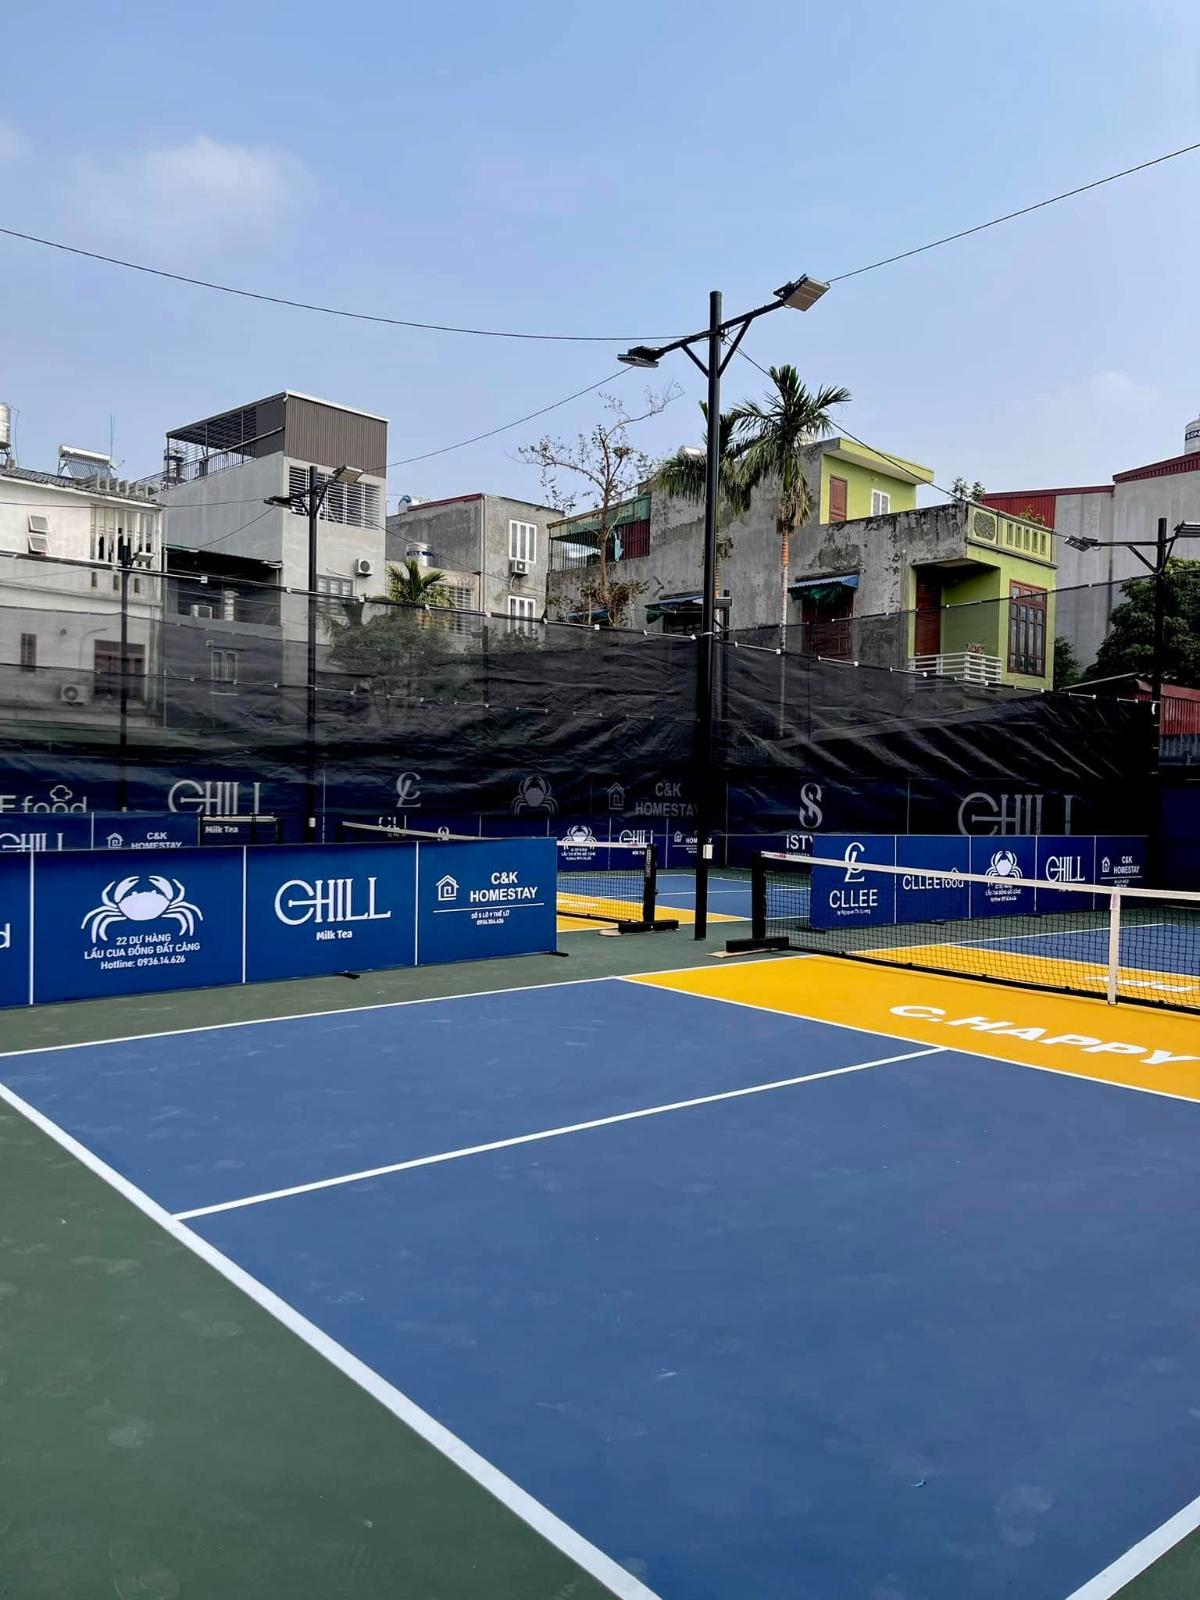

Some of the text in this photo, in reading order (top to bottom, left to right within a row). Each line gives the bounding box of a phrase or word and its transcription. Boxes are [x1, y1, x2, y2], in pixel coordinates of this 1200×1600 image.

[655, 782, 682, 797] C&K
[146, 832, 168, 840] C&K
[205, 826, 223, 834] Milk
[1121, 856, 1133, 864] C&K
[1045, 856, 1086, 882] CHILL
[1113, 866, 1140, 874] HOMESTAY
[491, 871, 519, 885] C&K
[470, 886, 539, 903] HOMESTAY
[829, 889, 878, 908] CLLEE
[274, 877, 392, 926] CHILL
[116, 933, 171, 945] 22 DƯ HÀNG
[316, 930, 353, 941] Milk Tea
[106, 948, 126, 958] CUA
[100, 960, 136, 970] Hotline:
[889, 1004, 1200, 1065] C.HAPPY
